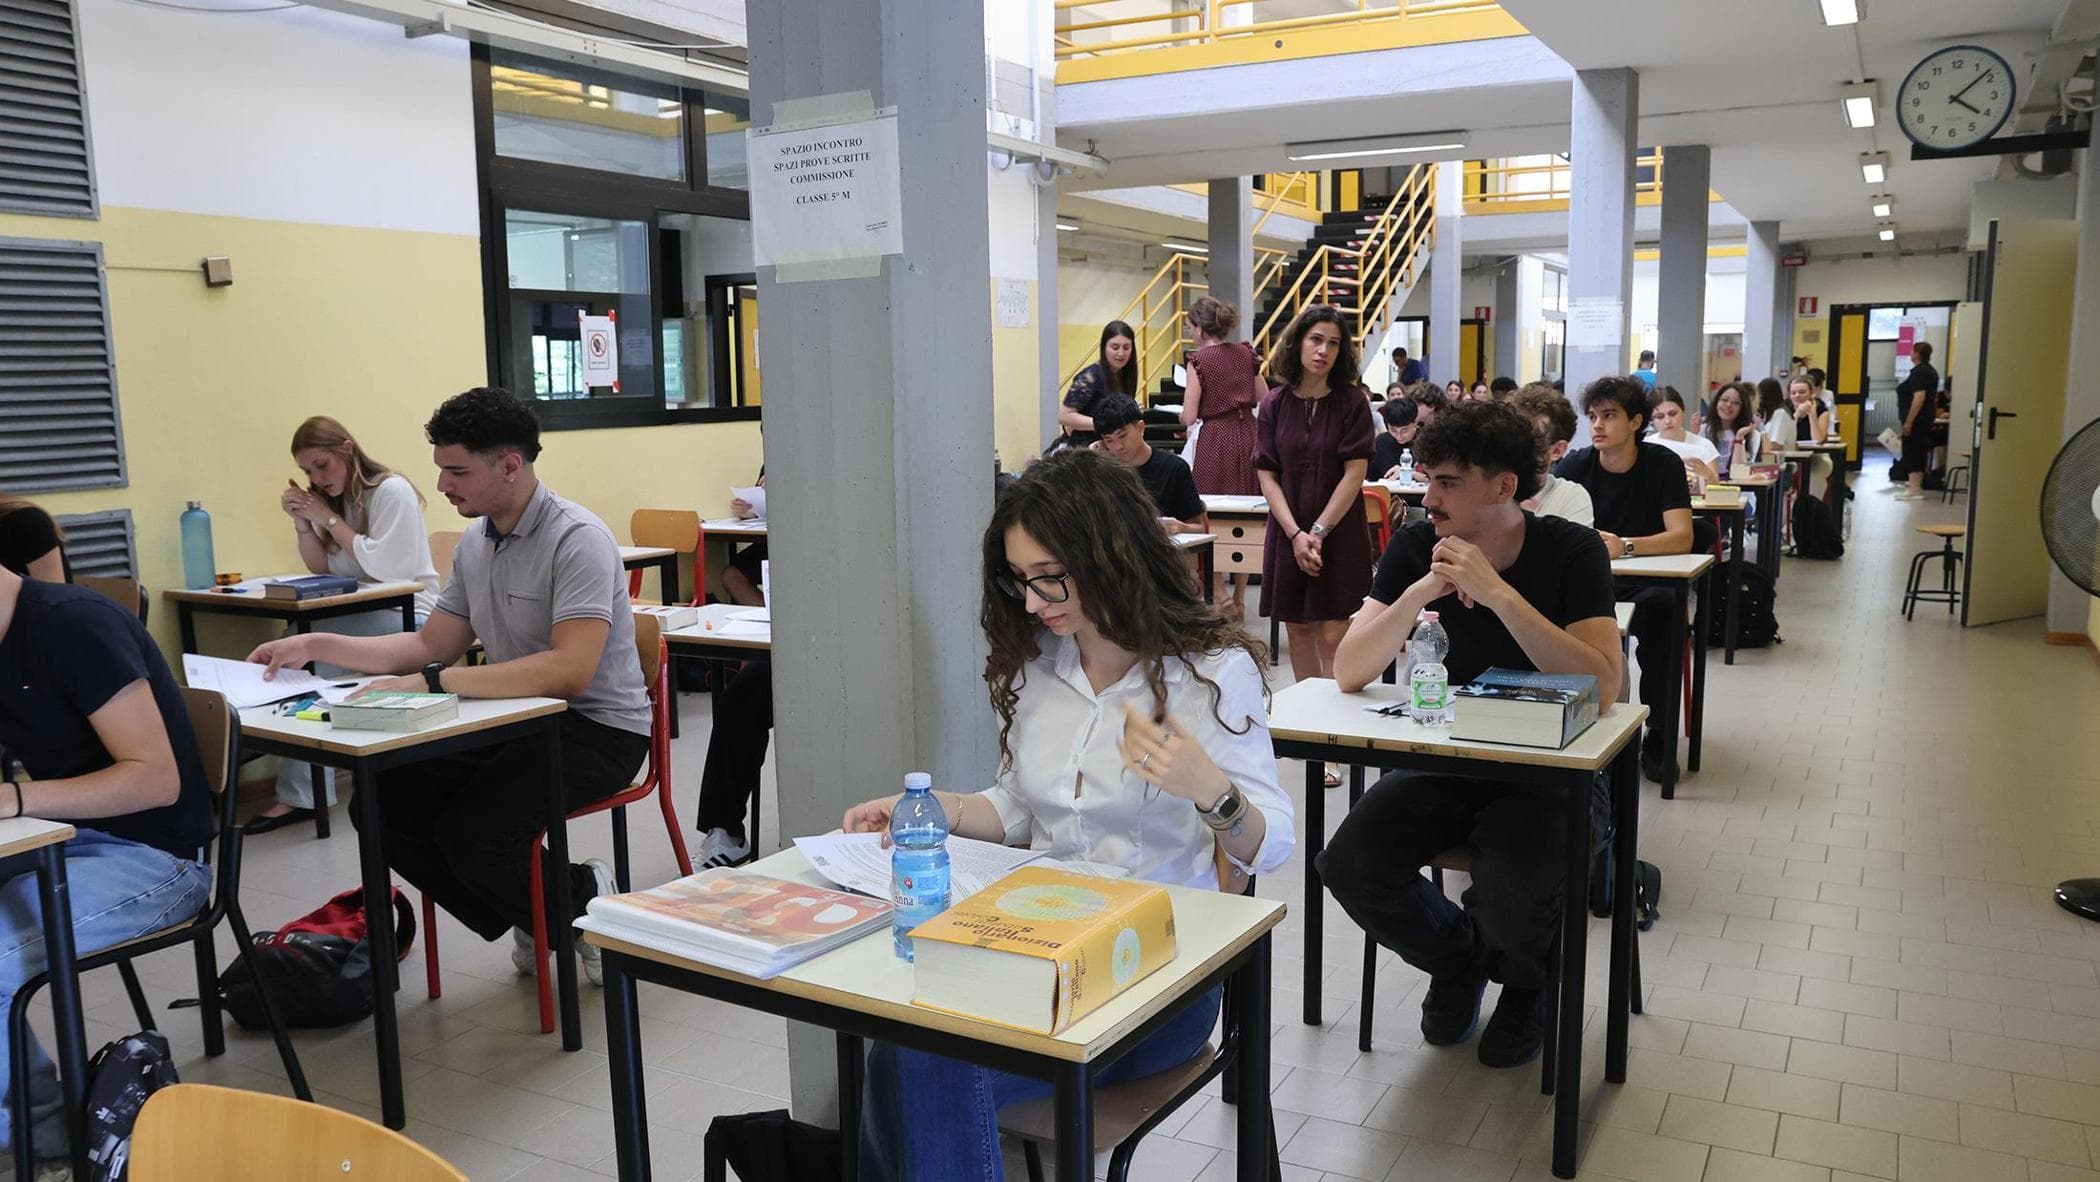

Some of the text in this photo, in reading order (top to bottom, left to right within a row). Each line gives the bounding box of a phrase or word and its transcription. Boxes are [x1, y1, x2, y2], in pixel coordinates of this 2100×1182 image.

[1952, 60, 1963, 69] 12
[1932, 67, 1942, 75] 11
[1987, 74, 1995, 83] 2
[1918, 81, 1930, 90] 10
[1990, 90, 1998, 100] 3
[1912, 98, 1920, 107] 9
[1983, 108, 1991, 117] 4
[1917, 114, 1925, 123] 8
[1931, 126, 1938, 135] 7
[1968, 122, 1976, 131] 5
[1948, 128, 1956, 137] 6
[780, 137, 863, 156] SPAZIO INCONTRO
[774, 152, 872, 172] SPAZI PROVE SCRITTE
[790, 169, 855, 184] COMMISSIONE
[796, 193, 830, 204] CLASSE
[842, 191, 851, 200] M
[952, 921, 1019, 938] Italiano
[972, 930, 1062, 949] Dizionario
